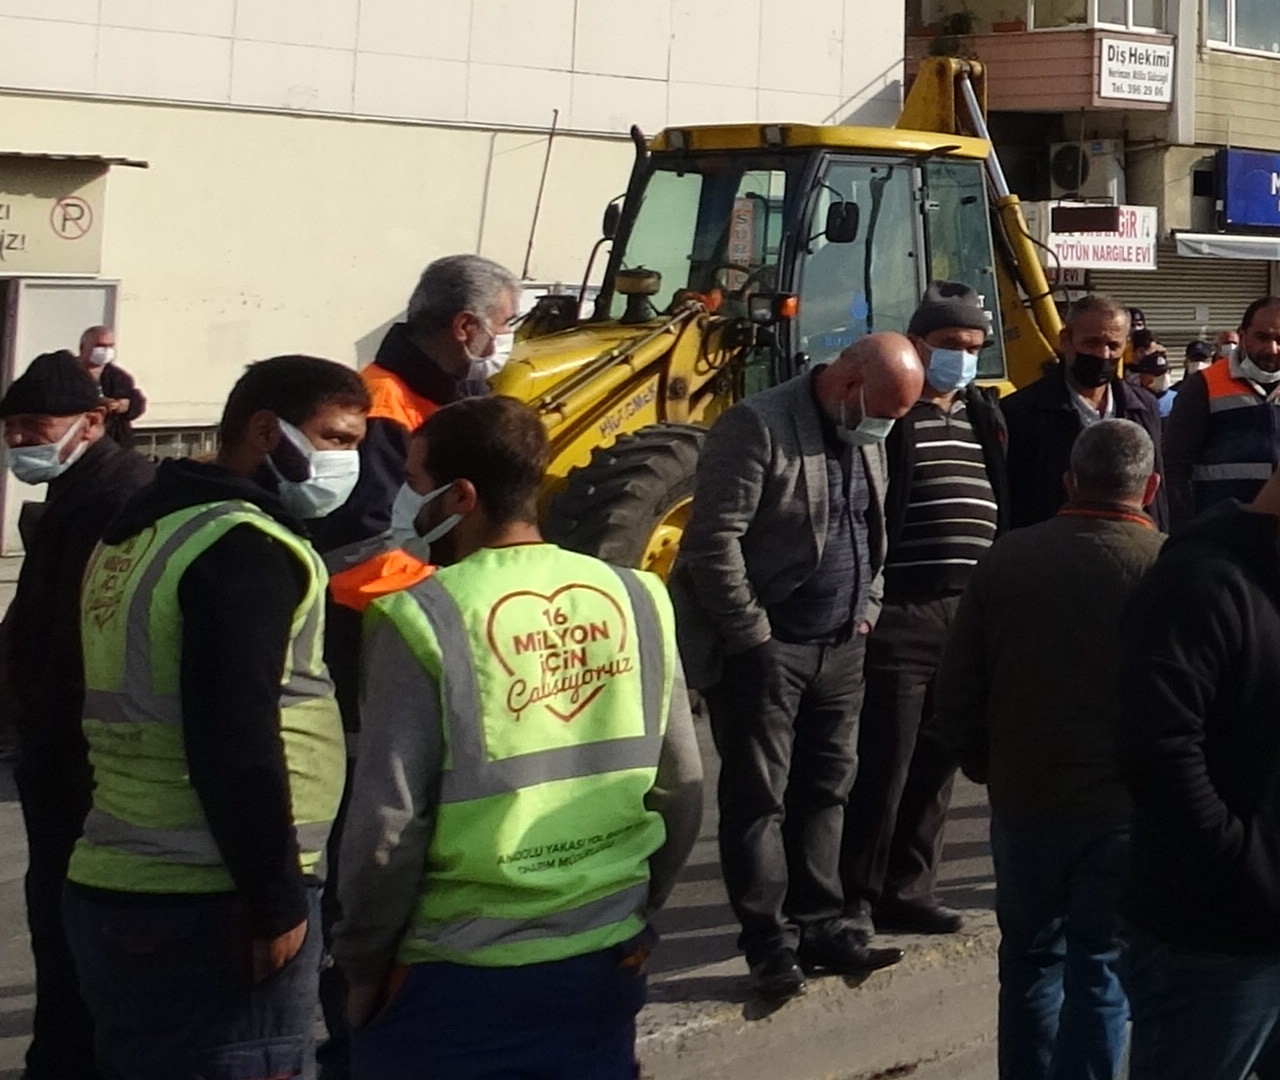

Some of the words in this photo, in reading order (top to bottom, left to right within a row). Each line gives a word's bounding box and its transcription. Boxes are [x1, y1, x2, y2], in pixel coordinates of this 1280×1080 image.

[1107, 44, 1126, 66] Diş
[1128, 46, 1170, 68] Hekimi
[1112, 82, 1126, 93] Tel.
[1055, 239, 1090, 261] TÜTÜN
[1092, 244, 1134, 263] NARGİLE
[1135, 243, 1151, 263] EVİ
[542, 606, 569, 627] 16
[512, 620, 610, 655] MİLYON
[540, 646, 588, 676] İÇİN
[544, 837, 585, 855] YAKASI
